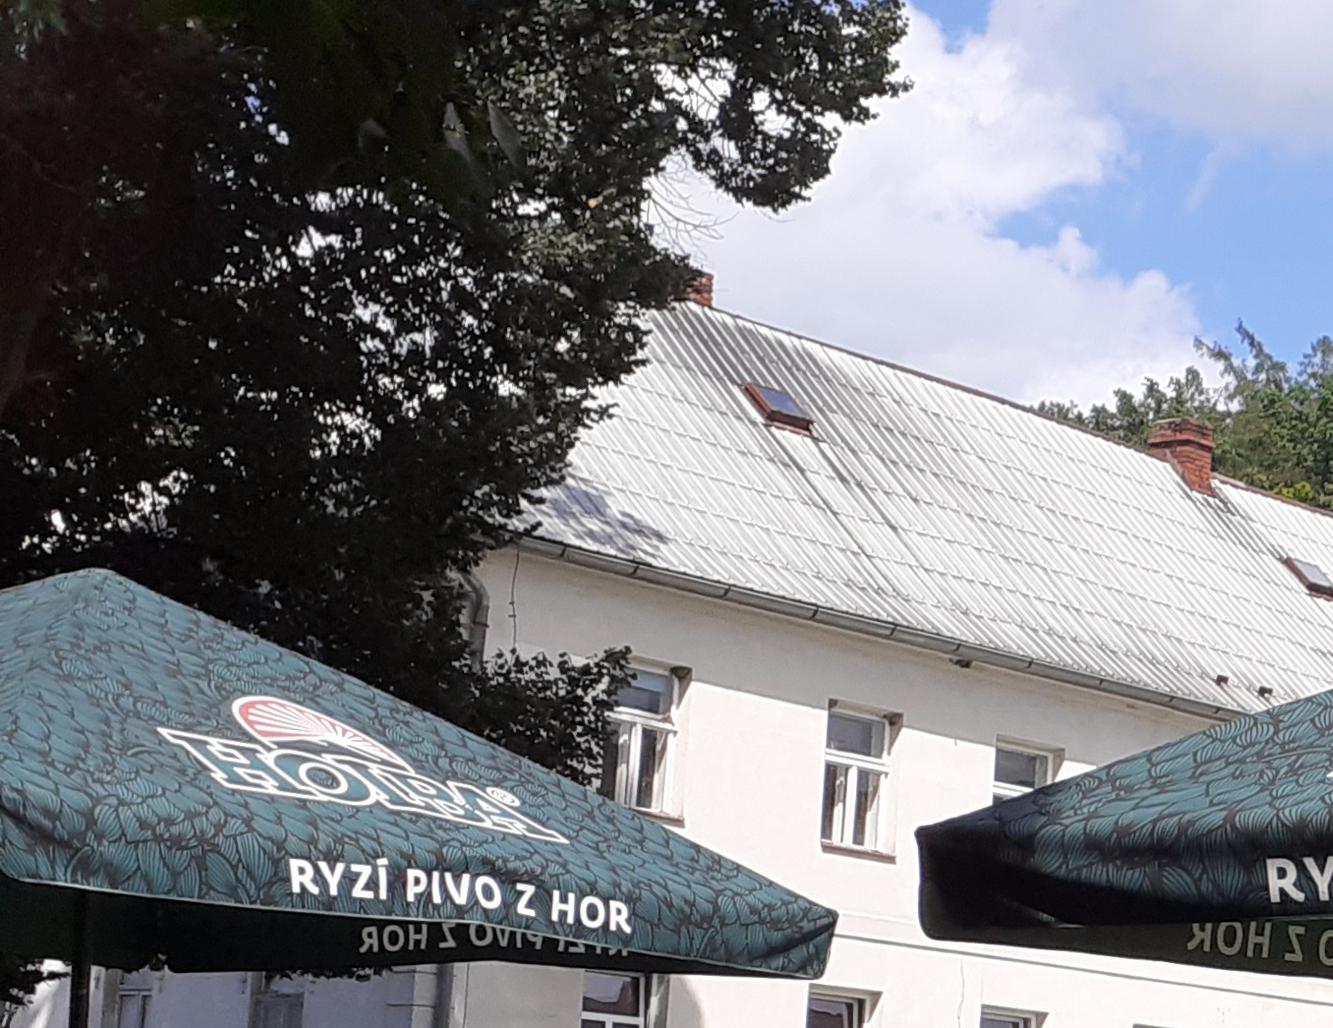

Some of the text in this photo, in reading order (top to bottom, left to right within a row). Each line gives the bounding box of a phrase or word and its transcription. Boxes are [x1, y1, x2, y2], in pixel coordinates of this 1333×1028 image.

[156, 726, 571, 845] HOLBA
[289, 858, 632, 934] RYZÍ PIVO Z HOR
